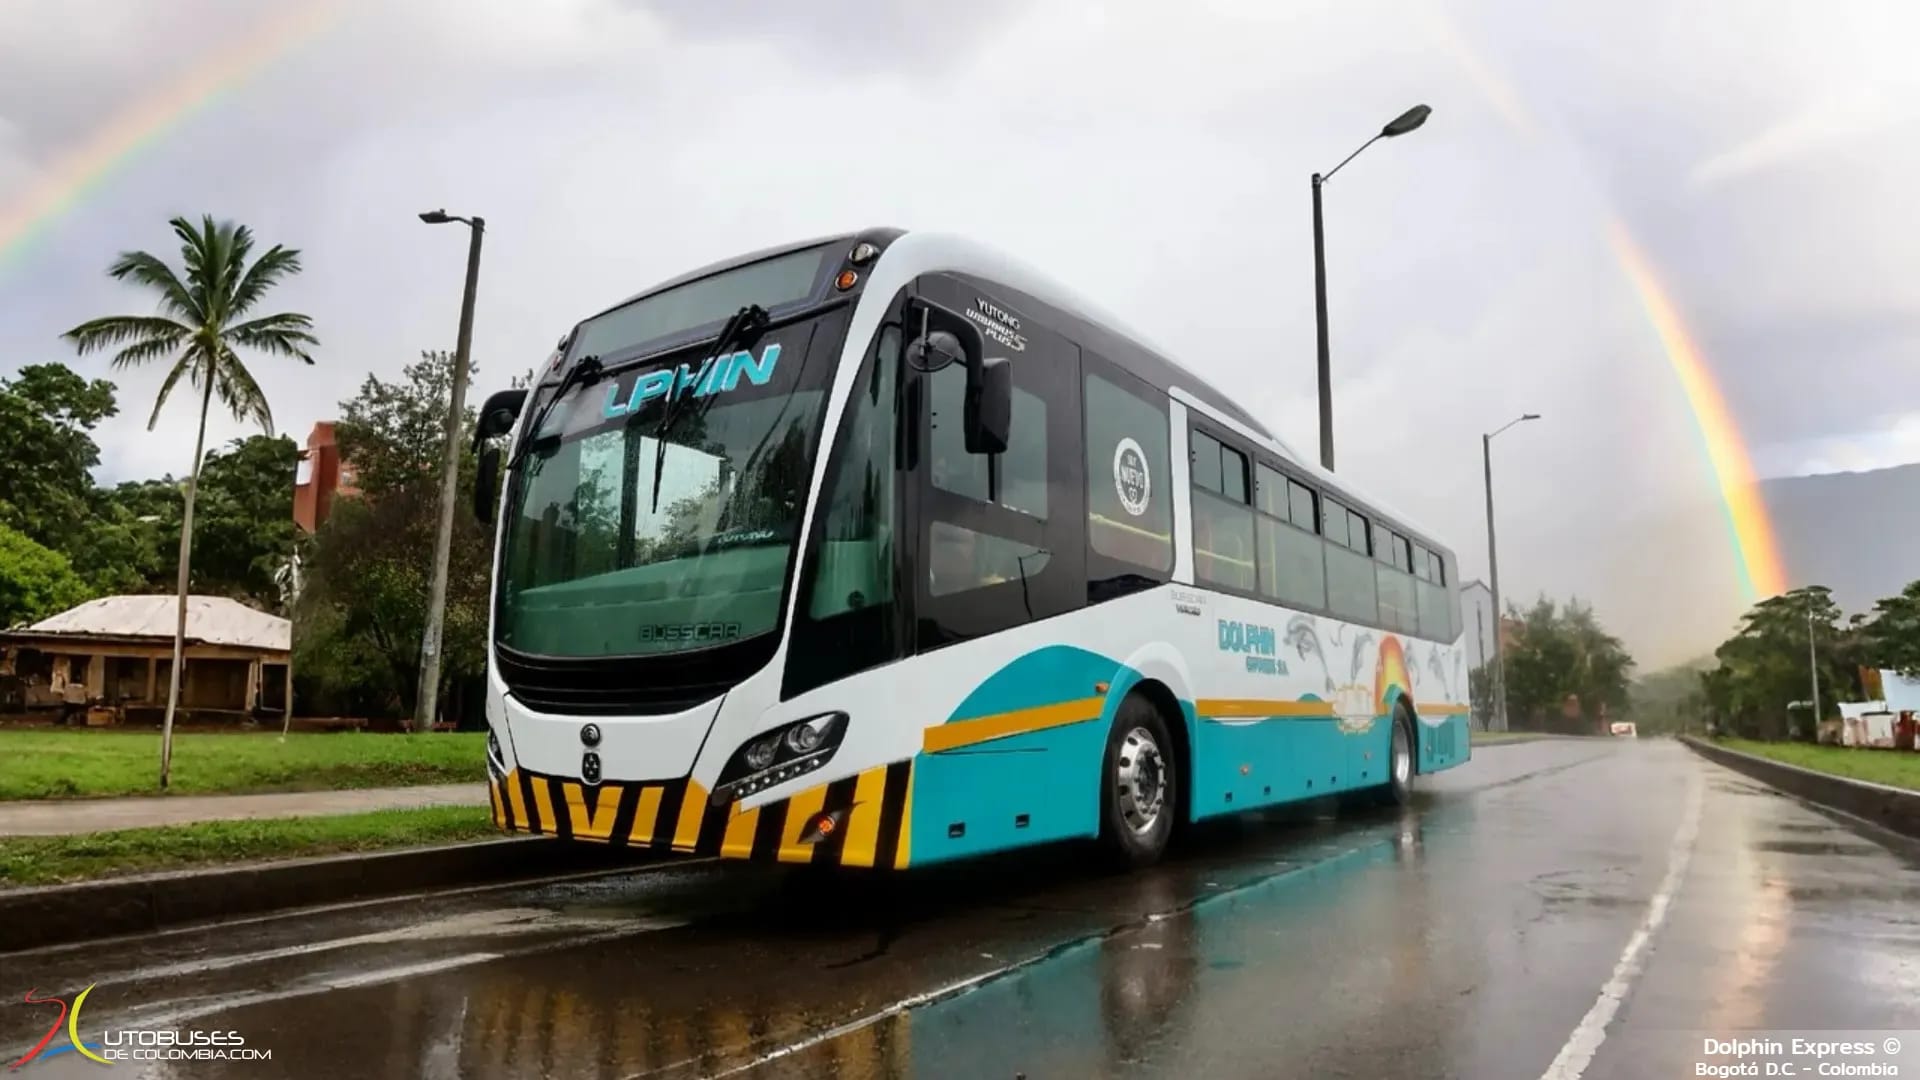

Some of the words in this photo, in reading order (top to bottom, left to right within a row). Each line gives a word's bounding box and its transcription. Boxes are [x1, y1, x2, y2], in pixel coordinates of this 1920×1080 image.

[976, 297, 1020, 330] YUTONG
[640, 623, 742, 641] BUSSCAR
[1218, 619, 1275, 656] DOLPHIN
